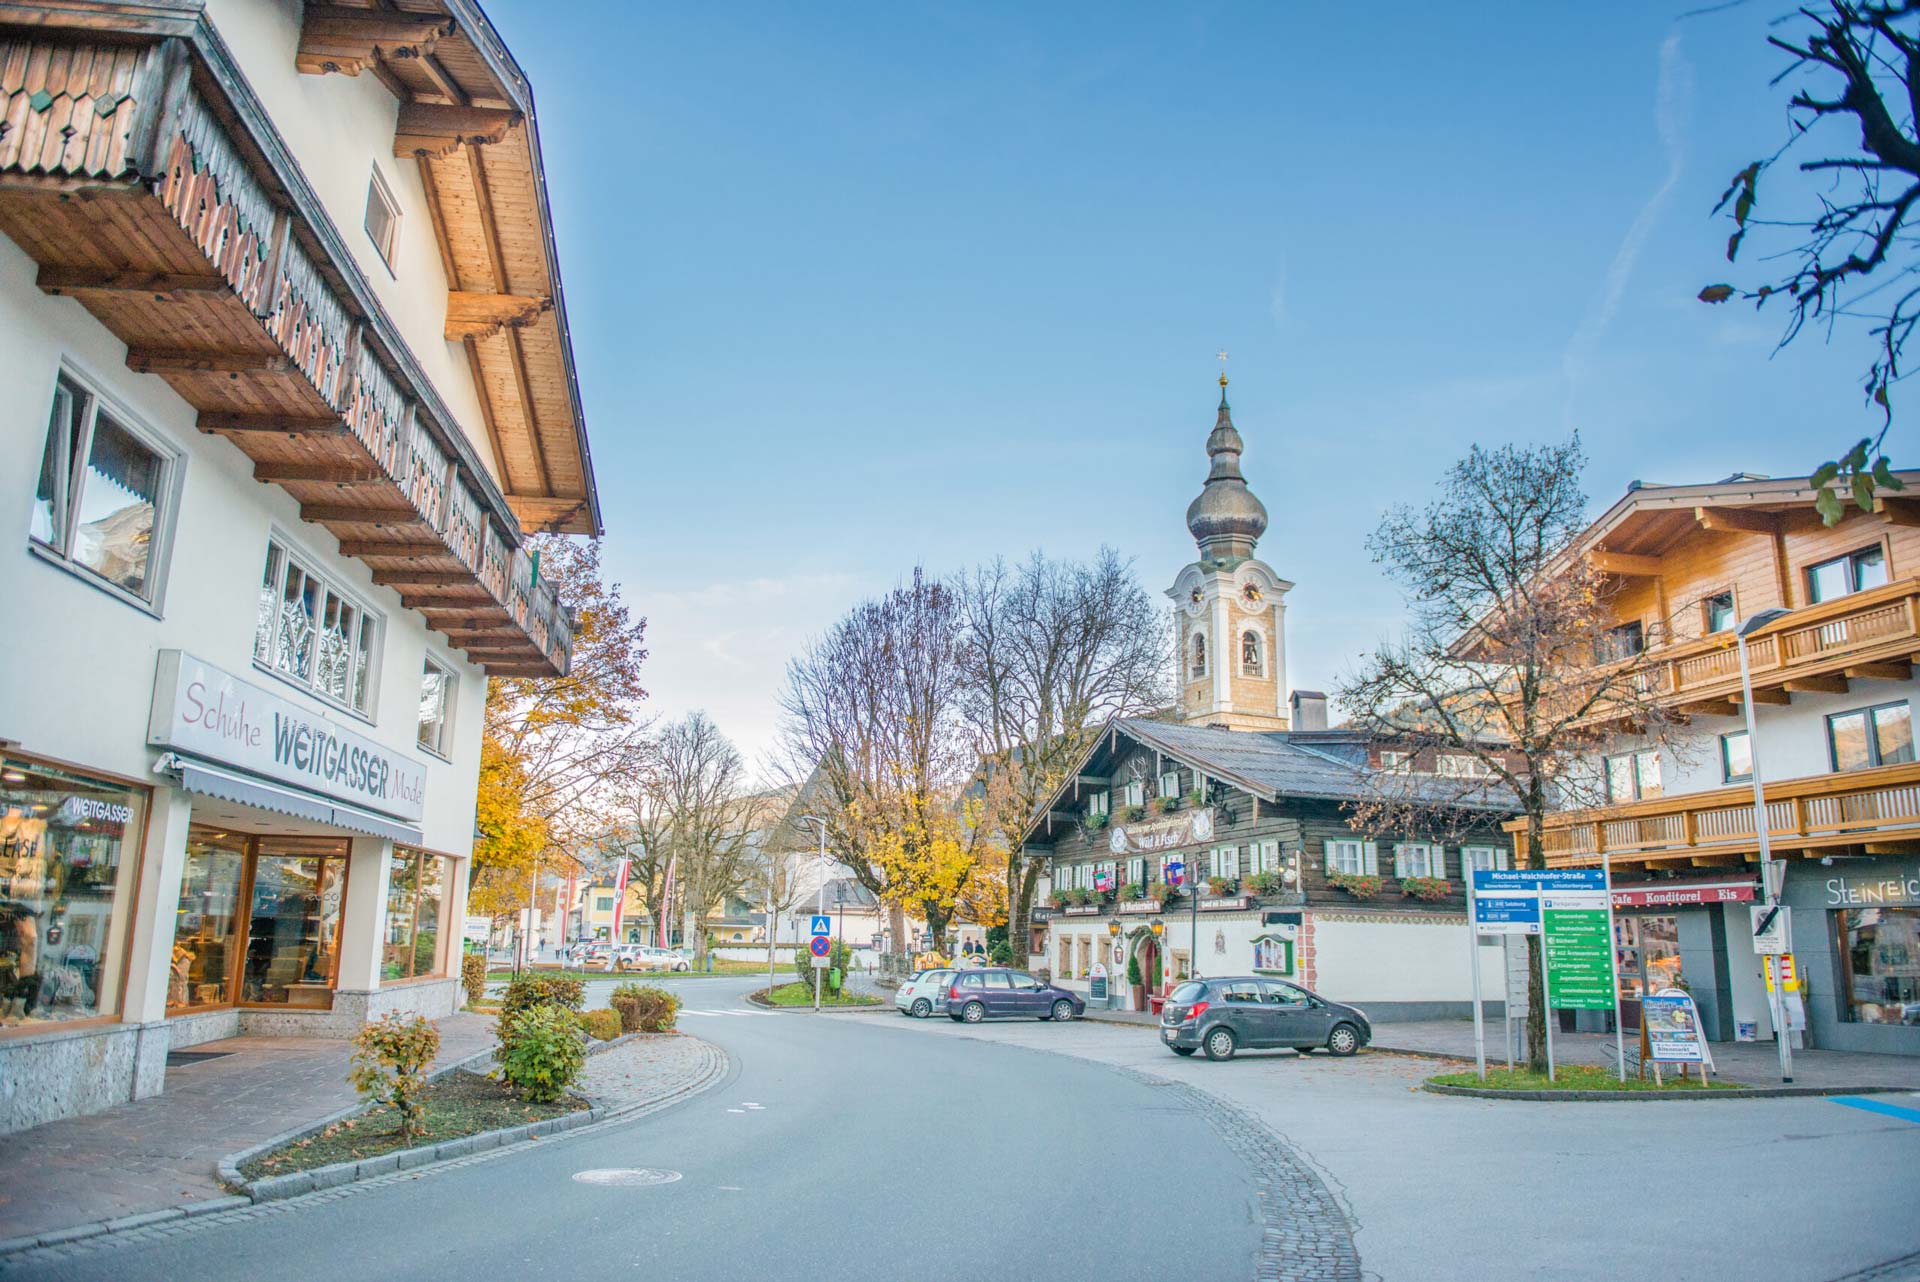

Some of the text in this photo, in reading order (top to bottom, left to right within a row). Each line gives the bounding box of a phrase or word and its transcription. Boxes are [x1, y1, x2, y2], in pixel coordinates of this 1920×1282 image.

[181, 681, 423, 806] Schuhe WEITGASSER Mode
[71, 797, 134, 824] WEITGASSER
[1491, 872, 1586, 881] Michael-Walchhofer-Straße
[1645, 890, 1701, 904] Konditorei
[1717, 889, 1738, 900] Eis
